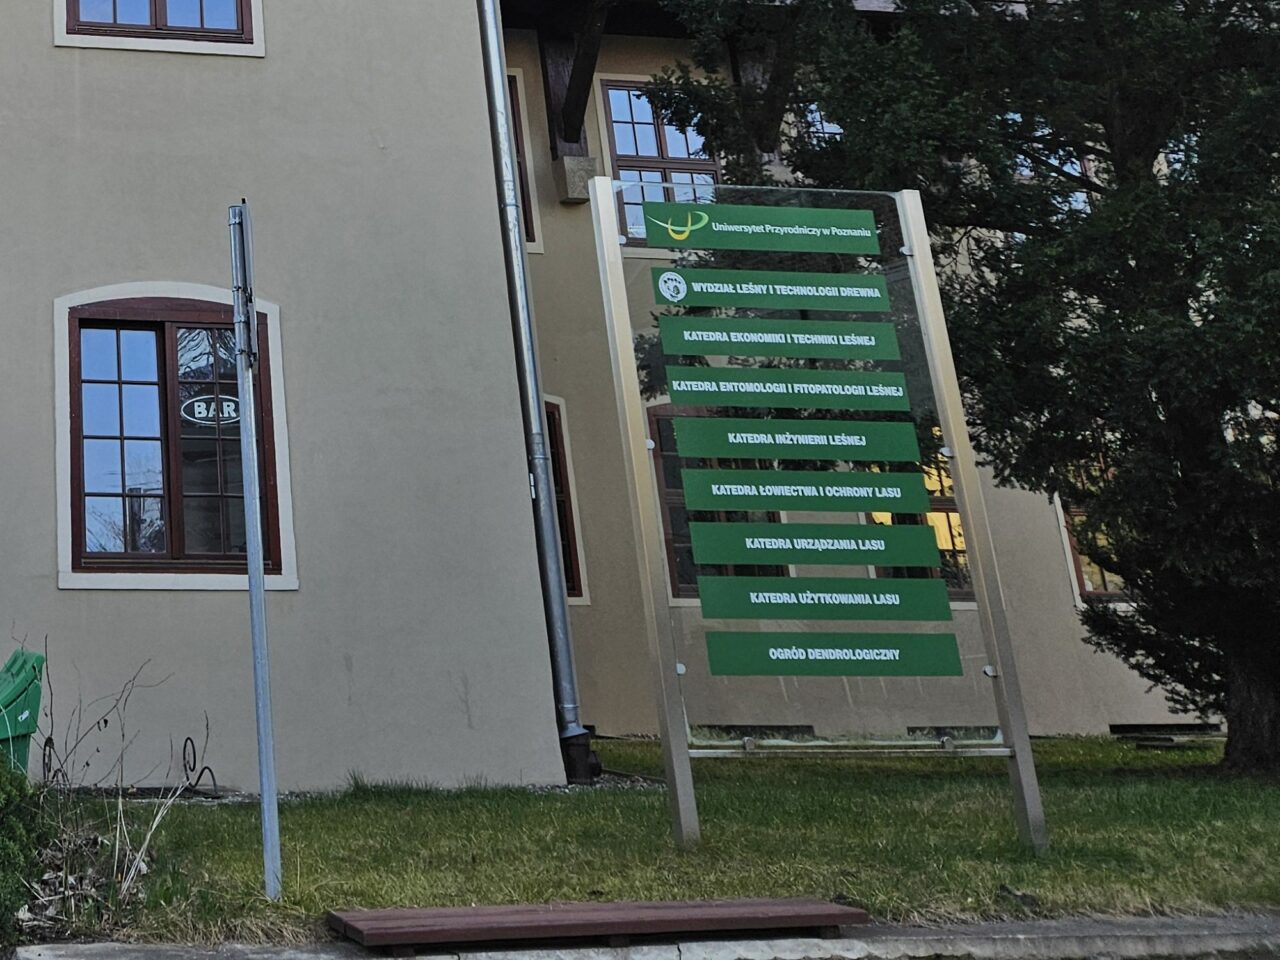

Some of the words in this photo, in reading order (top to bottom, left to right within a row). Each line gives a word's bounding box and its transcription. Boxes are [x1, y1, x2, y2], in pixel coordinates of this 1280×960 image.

[712, 222, 764, 234] Uniwersytet
[765, 224, 821, 237] Przyrodniczy
[831, 227, 872, 237] Poznaniu
[692, 282, 735, 293] WYDZIAŁ
[736, 282, 767, 294] LEŚNY
[769, 285, 773, 294] I
[774, 285, 839, 297] TECHNOLOGII
[840, 286, 881, 298] DREWNA
[684, 330, 729, 342] KATEDRA
[730, 331, 786, 343] EKONOMIKI
[787, 334, 791, 343] I
[792, 334, 838, 345] TECHNIKI
[839, 333, 875, 346] LEŚNEJ
[672, 380, 718, 392] KATEDRA
[719, 382, 786, 393] ENTOMOLOGII
[788, 384, 792, 393] I
[793, 384, 865, 396] FITOPATOLOGII
[866, 384, 903, 397] LEŚNEJ
[194, 402, 237, 418] BAR
[728, 432, 774, 444] KATEDRA
[775, 431, 828, 445] INŻYNIERII
[829, 433, 866, 446] LEŚNEJ
[712, 484, 758, 496] KATEDRA
[759, 486, 818, 497] ŁOWIECTWA
[819, 487, 824, 496] I
[825, 487, 874, 498] OCHRONY
[875, 488, 901, 498] LASU
[746, 538, 792, 549] KATEDRA
[793, 539, 858, 552] URZĄDZANIA
[858, 540, 885, 551] LASU
[750, 592, 797, 604] KATEDRA
[798, 590, 872, 605] UŻYTKOWANIA
[873, 594, 900, 605] LASU
[769, 645, 807, 660] OGRÓD
[807, 648, 900, 660] DENDROLOGICZNY
